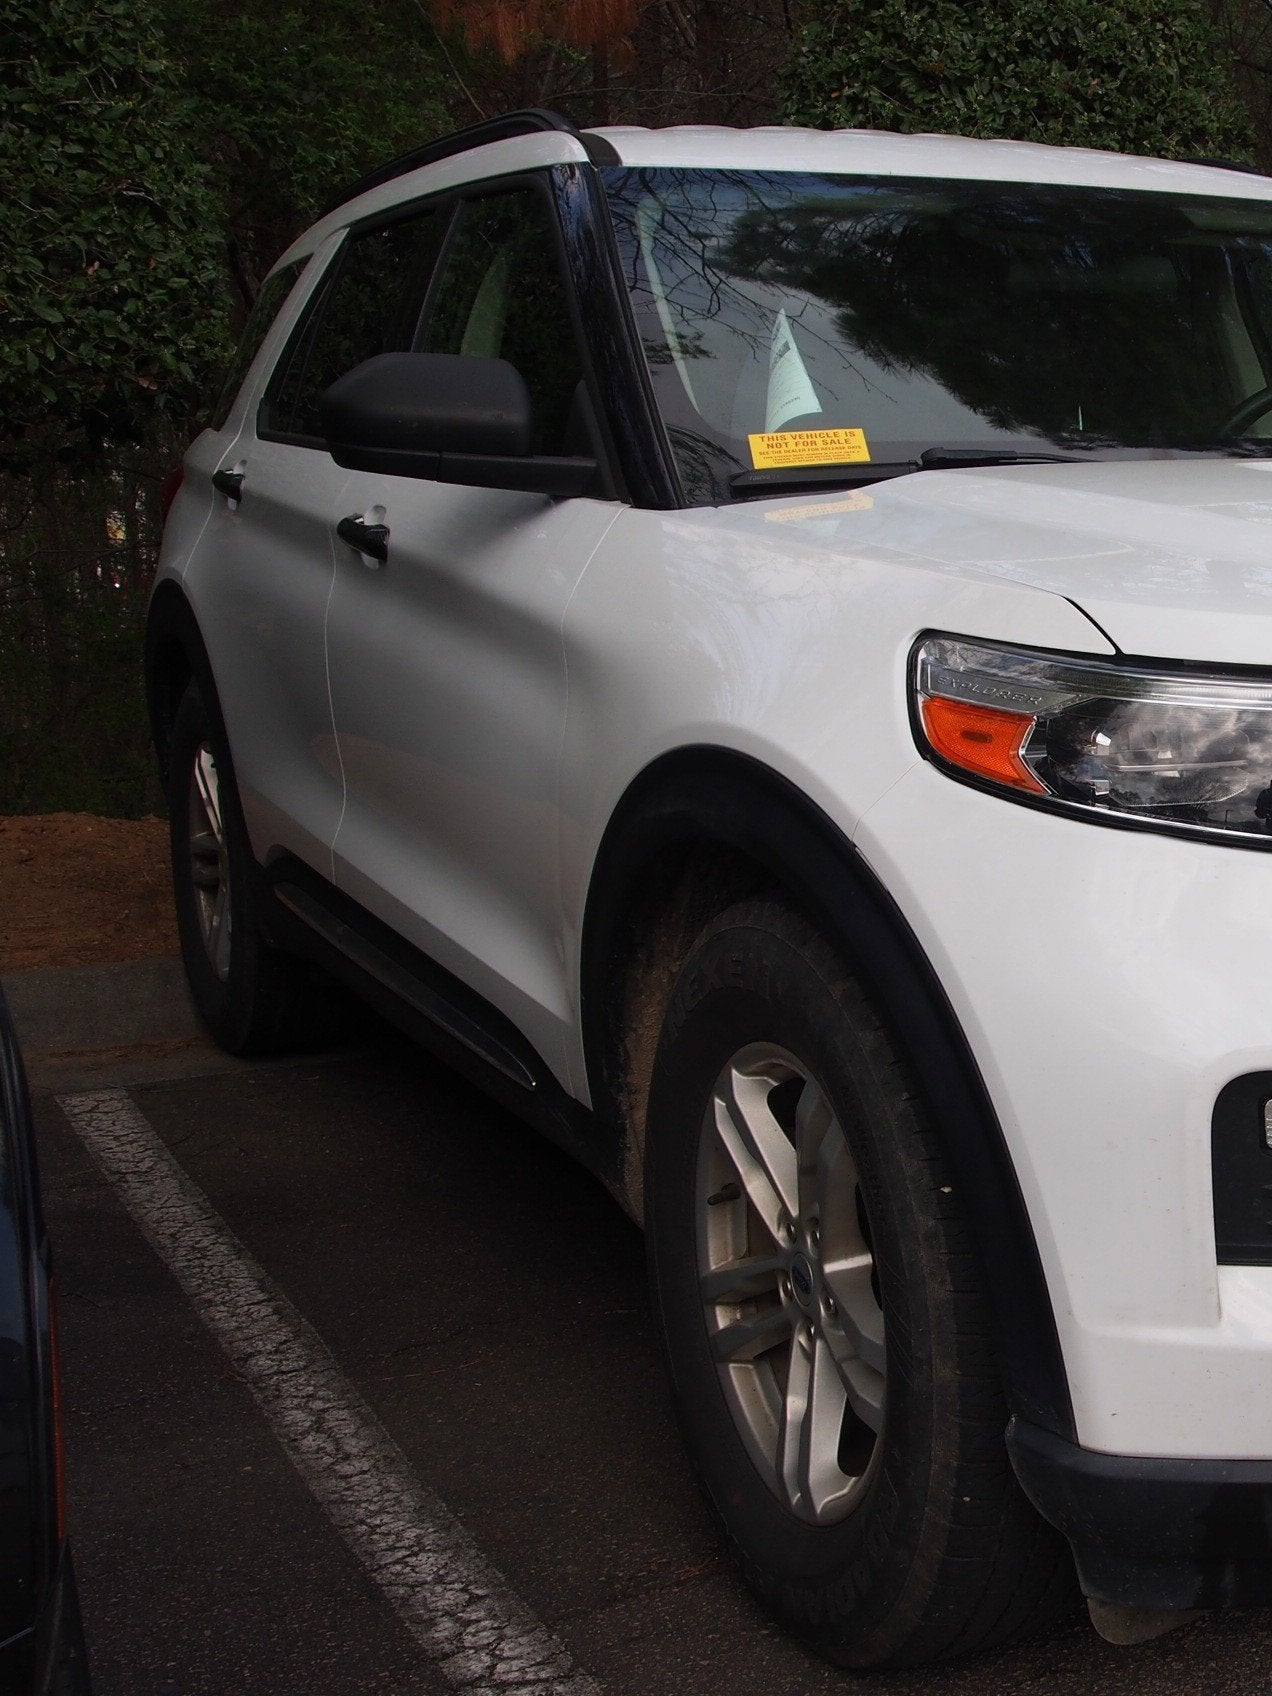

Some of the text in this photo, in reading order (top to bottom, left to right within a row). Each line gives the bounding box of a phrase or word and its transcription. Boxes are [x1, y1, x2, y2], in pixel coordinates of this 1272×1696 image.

[759, 430, 856, 443] THIS VEHICLE IS
[766, 441, 789, 450] NOT
[822, 437, 852, 446] SALE
[937, 675, 1042, 705] EXPLORER
